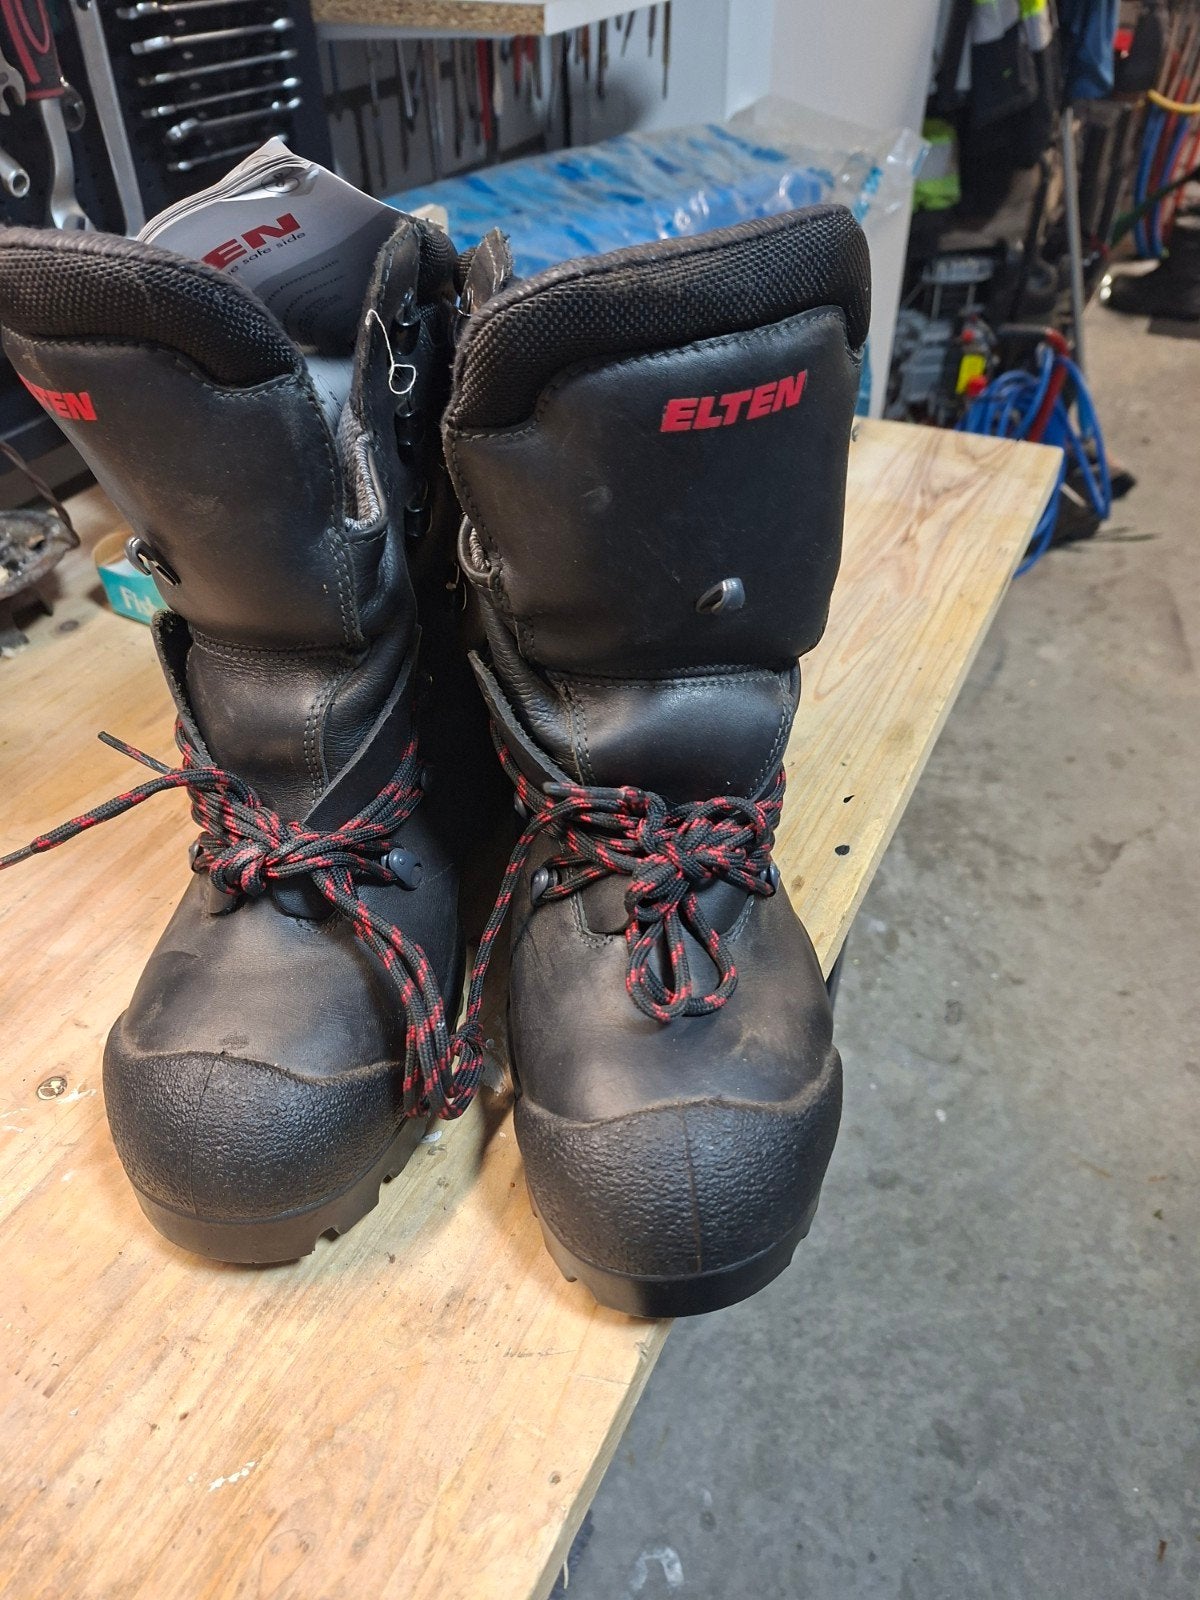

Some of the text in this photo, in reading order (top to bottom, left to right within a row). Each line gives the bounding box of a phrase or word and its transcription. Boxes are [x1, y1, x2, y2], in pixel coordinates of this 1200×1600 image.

[242, 231, 306, 264] safe side
[16, 371, 98, 420] TEN
[660, 369, 808, 432] ELTEN
